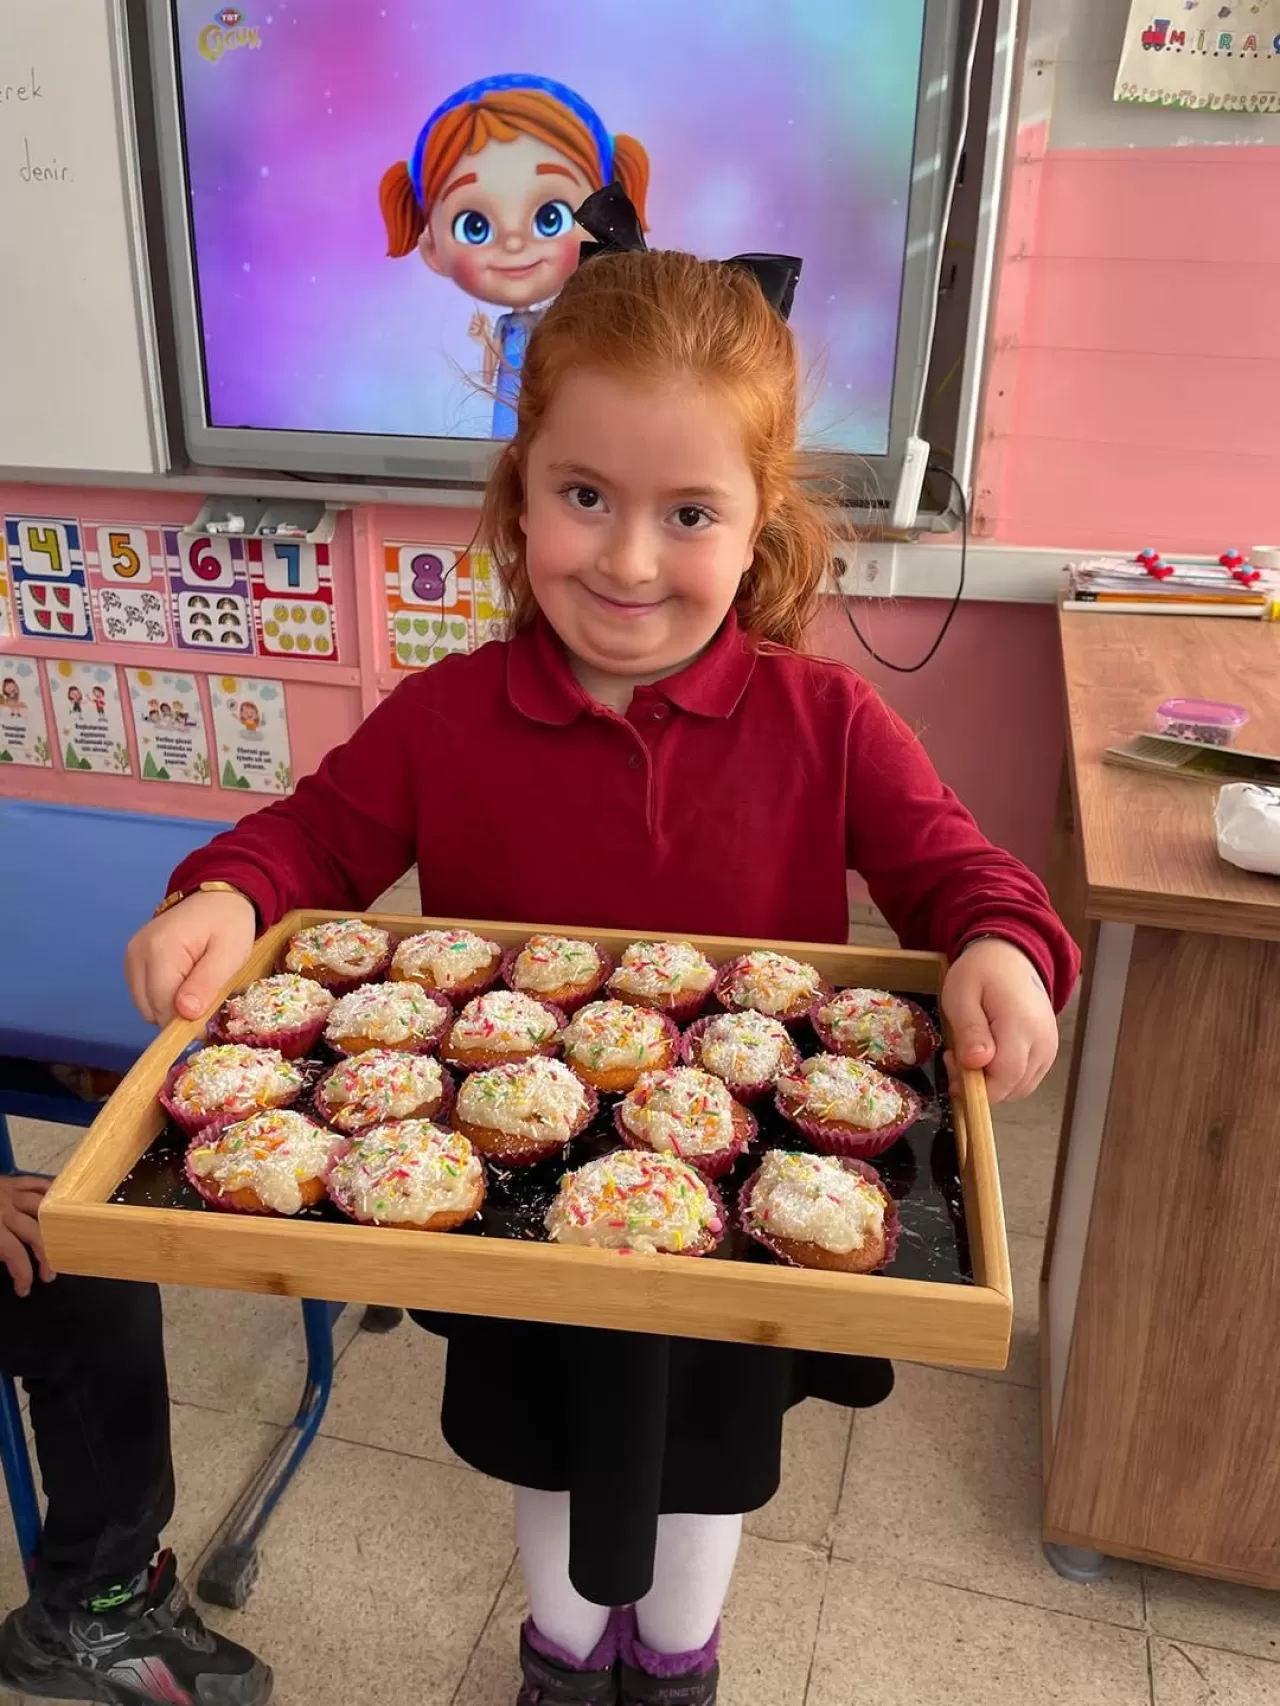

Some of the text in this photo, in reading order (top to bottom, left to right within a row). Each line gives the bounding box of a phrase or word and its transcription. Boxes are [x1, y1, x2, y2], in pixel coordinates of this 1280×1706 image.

[0, 67, 43, 101] rek
[27, 527, 63, 571] 4
[109, 533, 141, 578] 5
[189, 537, 222, 581] 6
[274, 543, 301, 588] 7
[411, 553, 446, 601] 8
